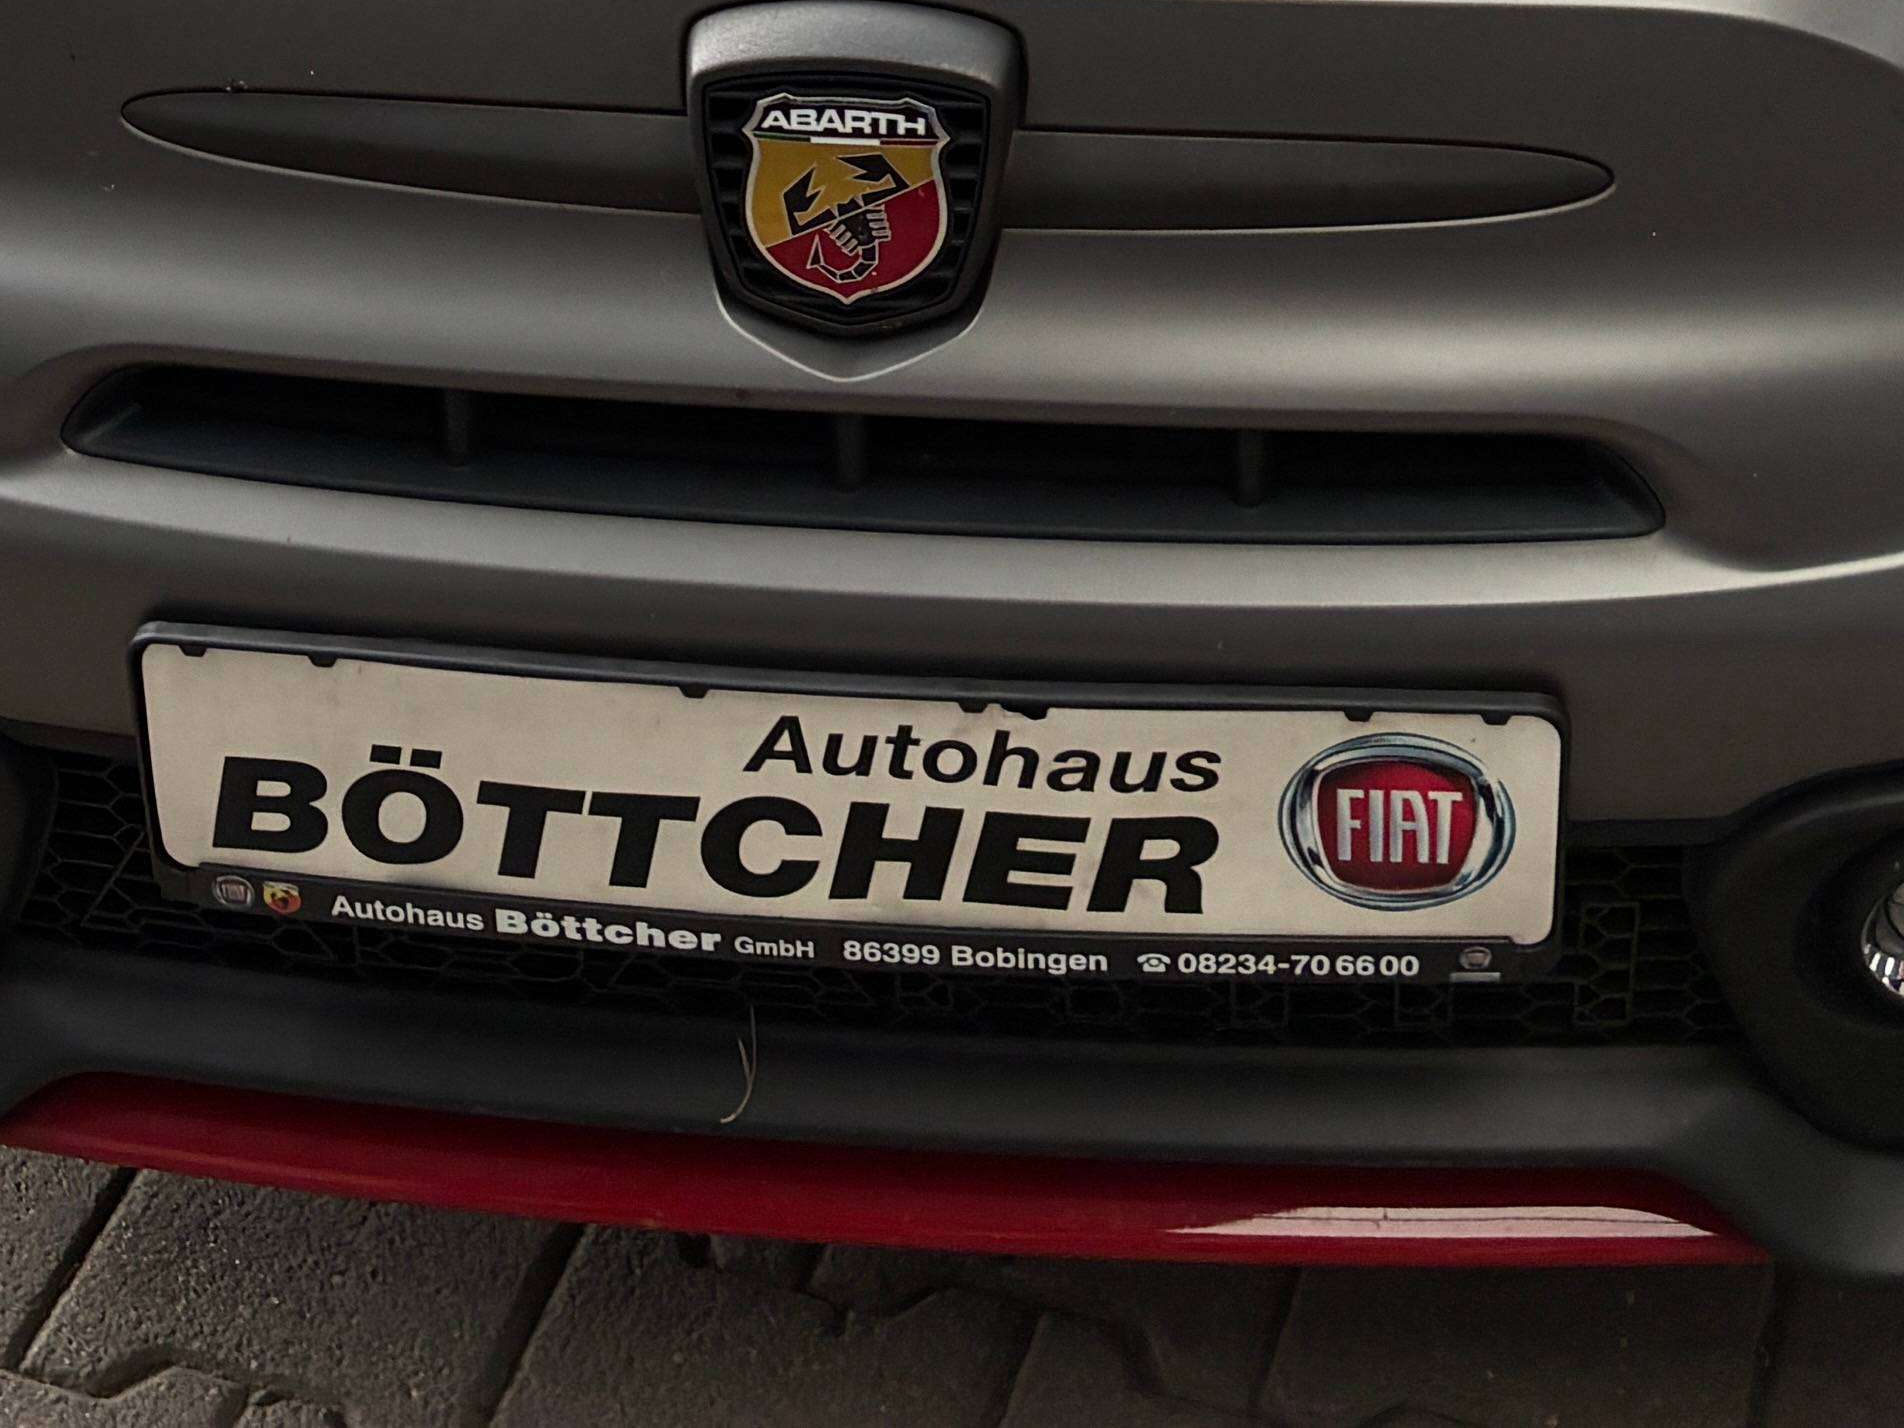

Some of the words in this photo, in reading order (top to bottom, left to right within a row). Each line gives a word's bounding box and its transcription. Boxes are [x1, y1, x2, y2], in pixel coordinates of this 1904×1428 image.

[761, 108, 926, 136] ABARTH
[742, 715, 1223, 794] Autohaus
[211, 745, 1222, 916] BÖTTCHER
[1336, 788, 1464, 865] FIAT
[331, 894, 485, 932] Autohaus
[496, 908, 722, 952] Böttcher
[734, 936, 816, 959] GmbH
[843, 940, 941, 966] 86399
[950, 945, 1109, 976] Bobingen
